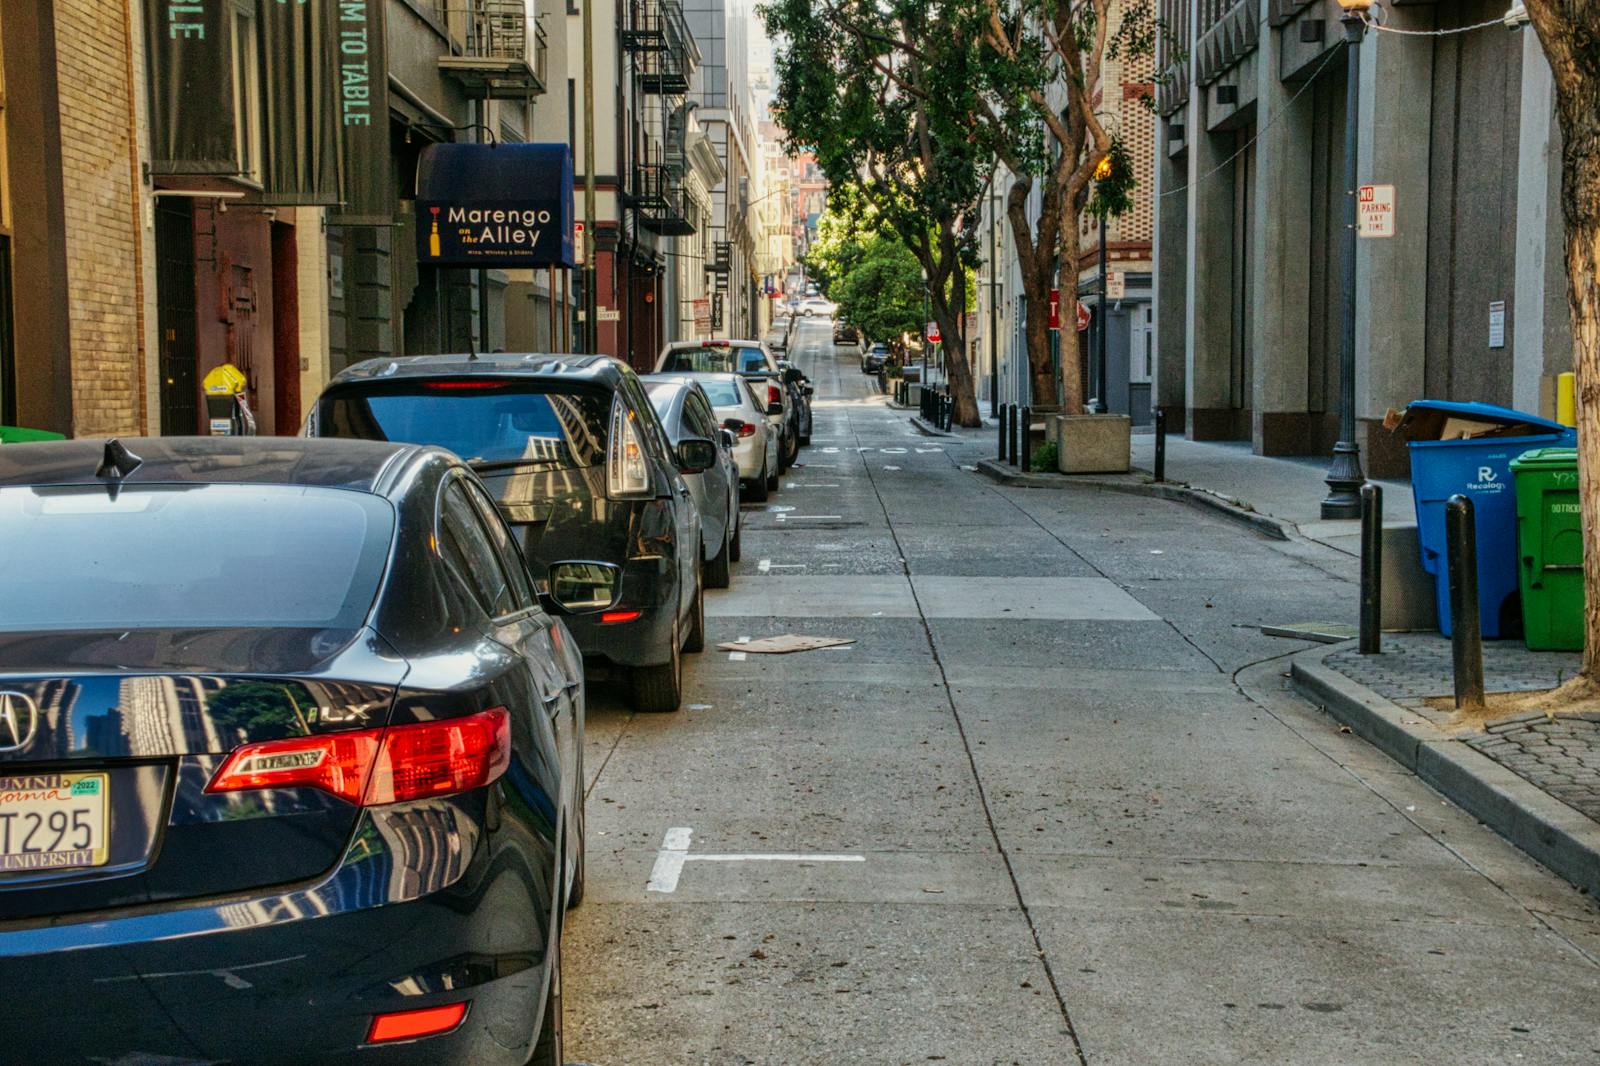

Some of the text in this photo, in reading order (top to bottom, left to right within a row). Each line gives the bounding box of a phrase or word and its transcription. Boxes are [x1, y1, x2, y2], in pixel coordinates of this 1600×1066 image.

[168, 0, 205, 40] LE
[340, 28, 368, 55] TO
[341, 60, 371, 126] TABLE
[1360, 188, 1374, 201] NO
[448, 207, 551, 227] Marengo
[1361, 202, 1392, 213] PARKING
[462, 226, 540, 247] the Alley
[307, 704, 371, 723] ILX
[4, 851, 91, 869] UNIVERSITY
